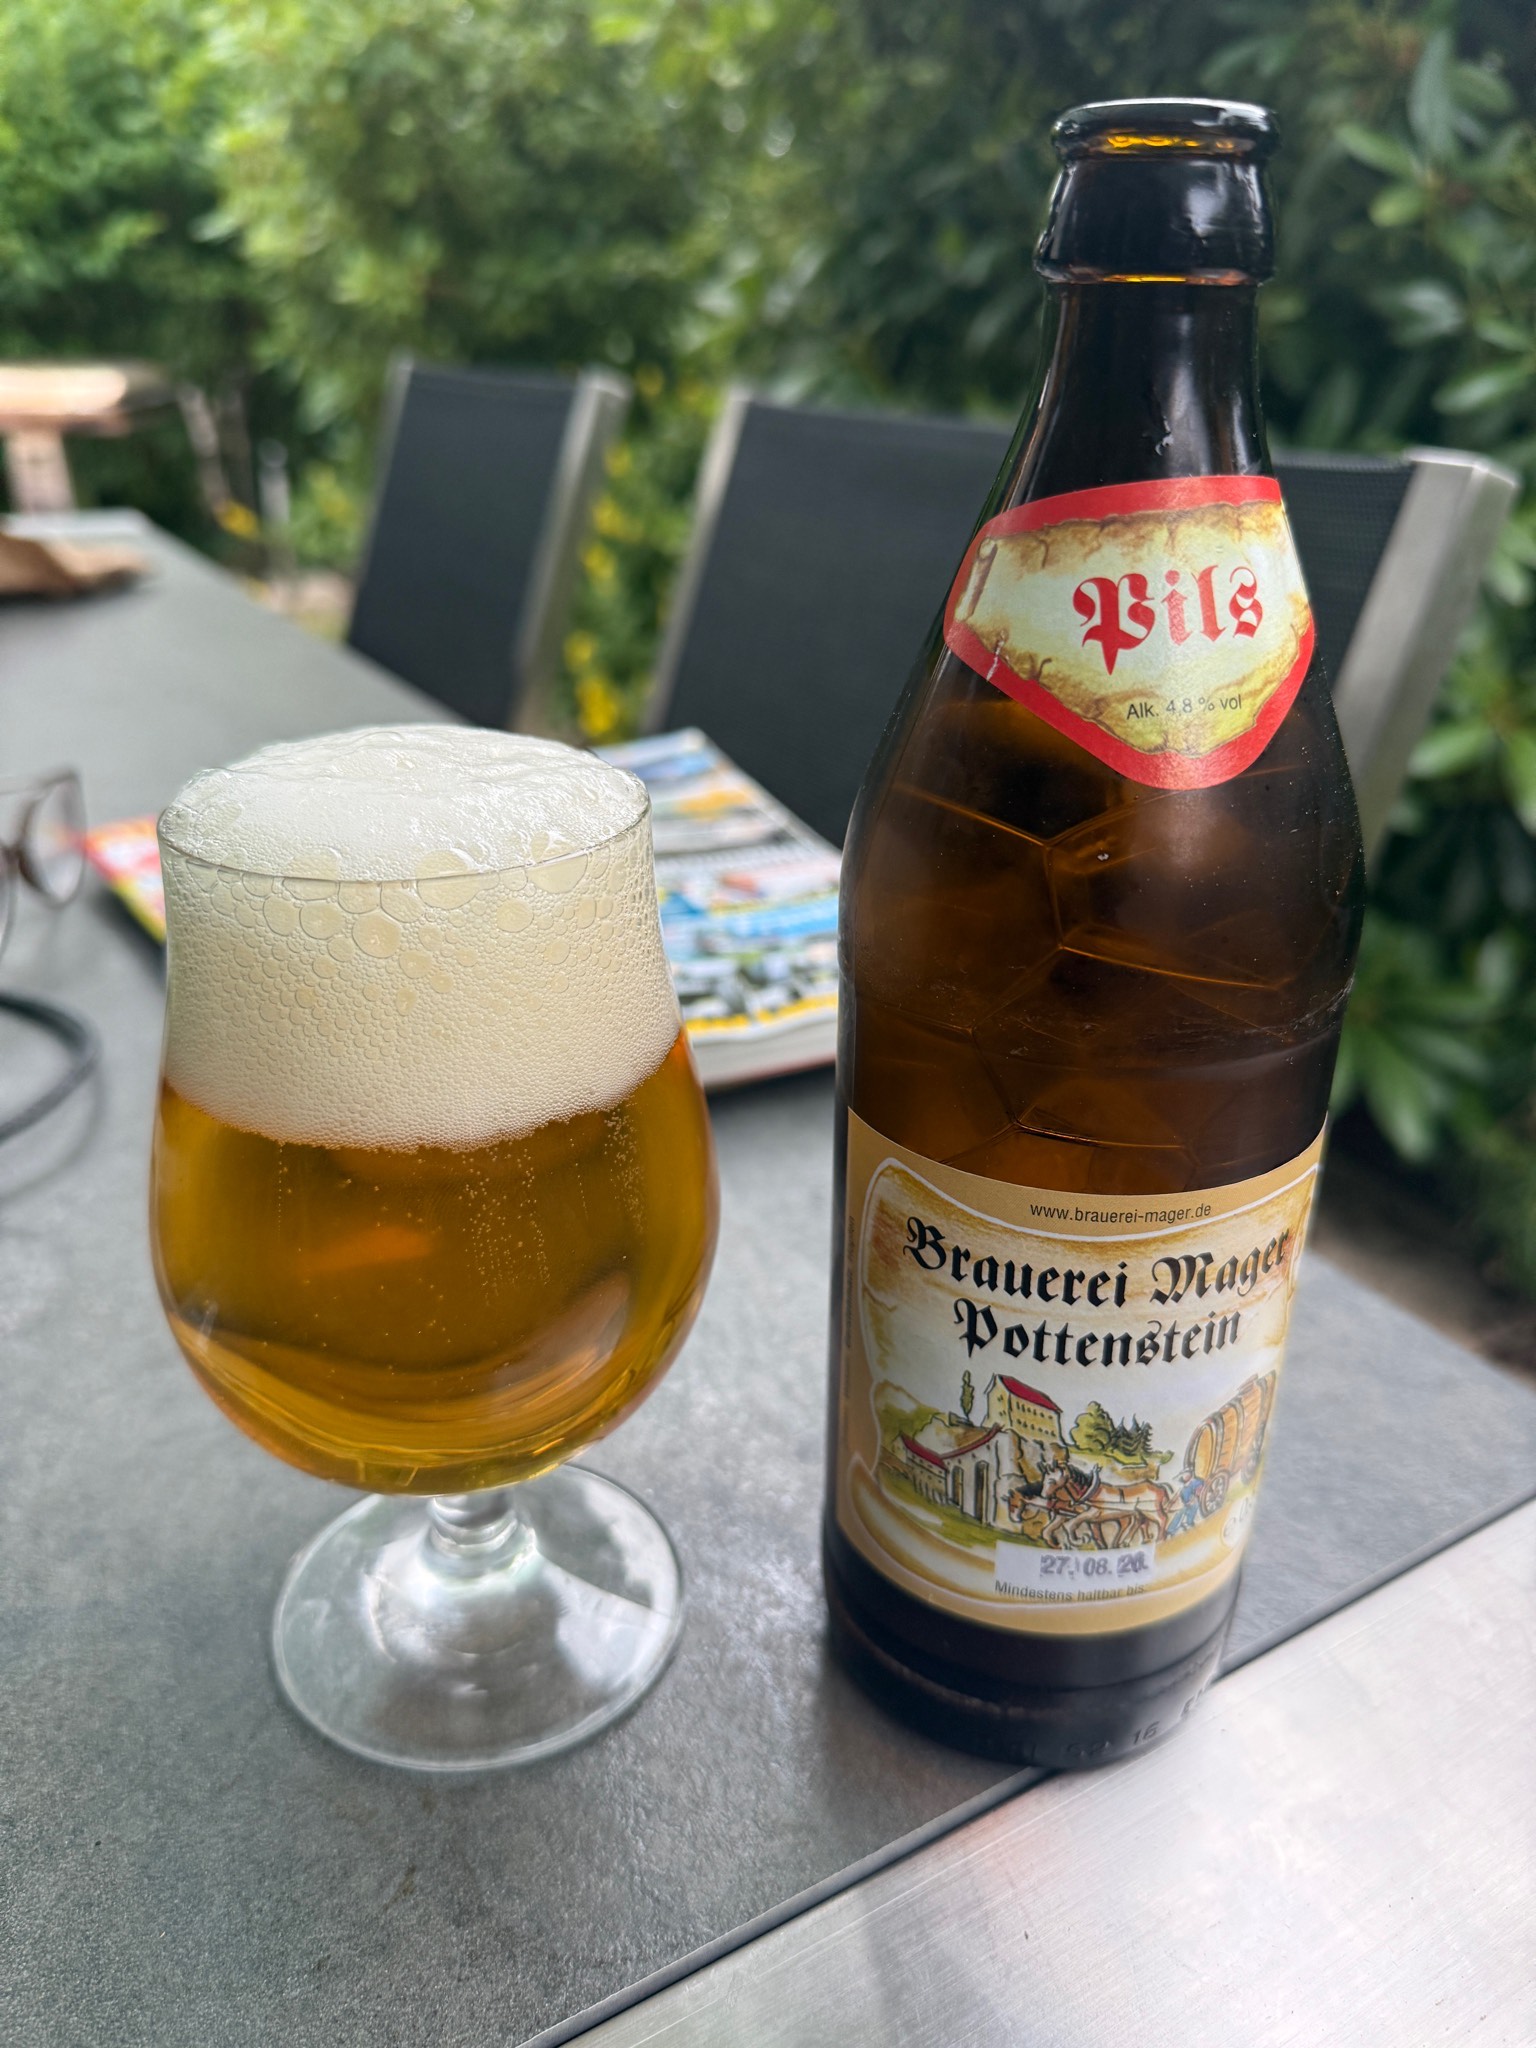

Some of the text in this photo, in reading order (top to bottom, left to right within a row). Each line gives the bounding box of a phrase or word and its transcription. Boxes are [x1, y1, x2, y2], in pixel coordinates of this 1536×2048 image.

[1072, 564, 1264, 676] Pils
[1126, 702, 1159, 720] Alk.
[1220, 694, 1242, 710] vol
[1030, 1203, 1212, 1225] www.brauerei-mager.de
[903, 1216, 1128, 1308] Brauerei
[1149, 1228, 1290, 1306] Mager
[953, 1297, 1241, 1368] Pottenstein
[995, 1579, 1073, 1601] Mindestens
[1077, 1588, 1122, 1601] haltbar
